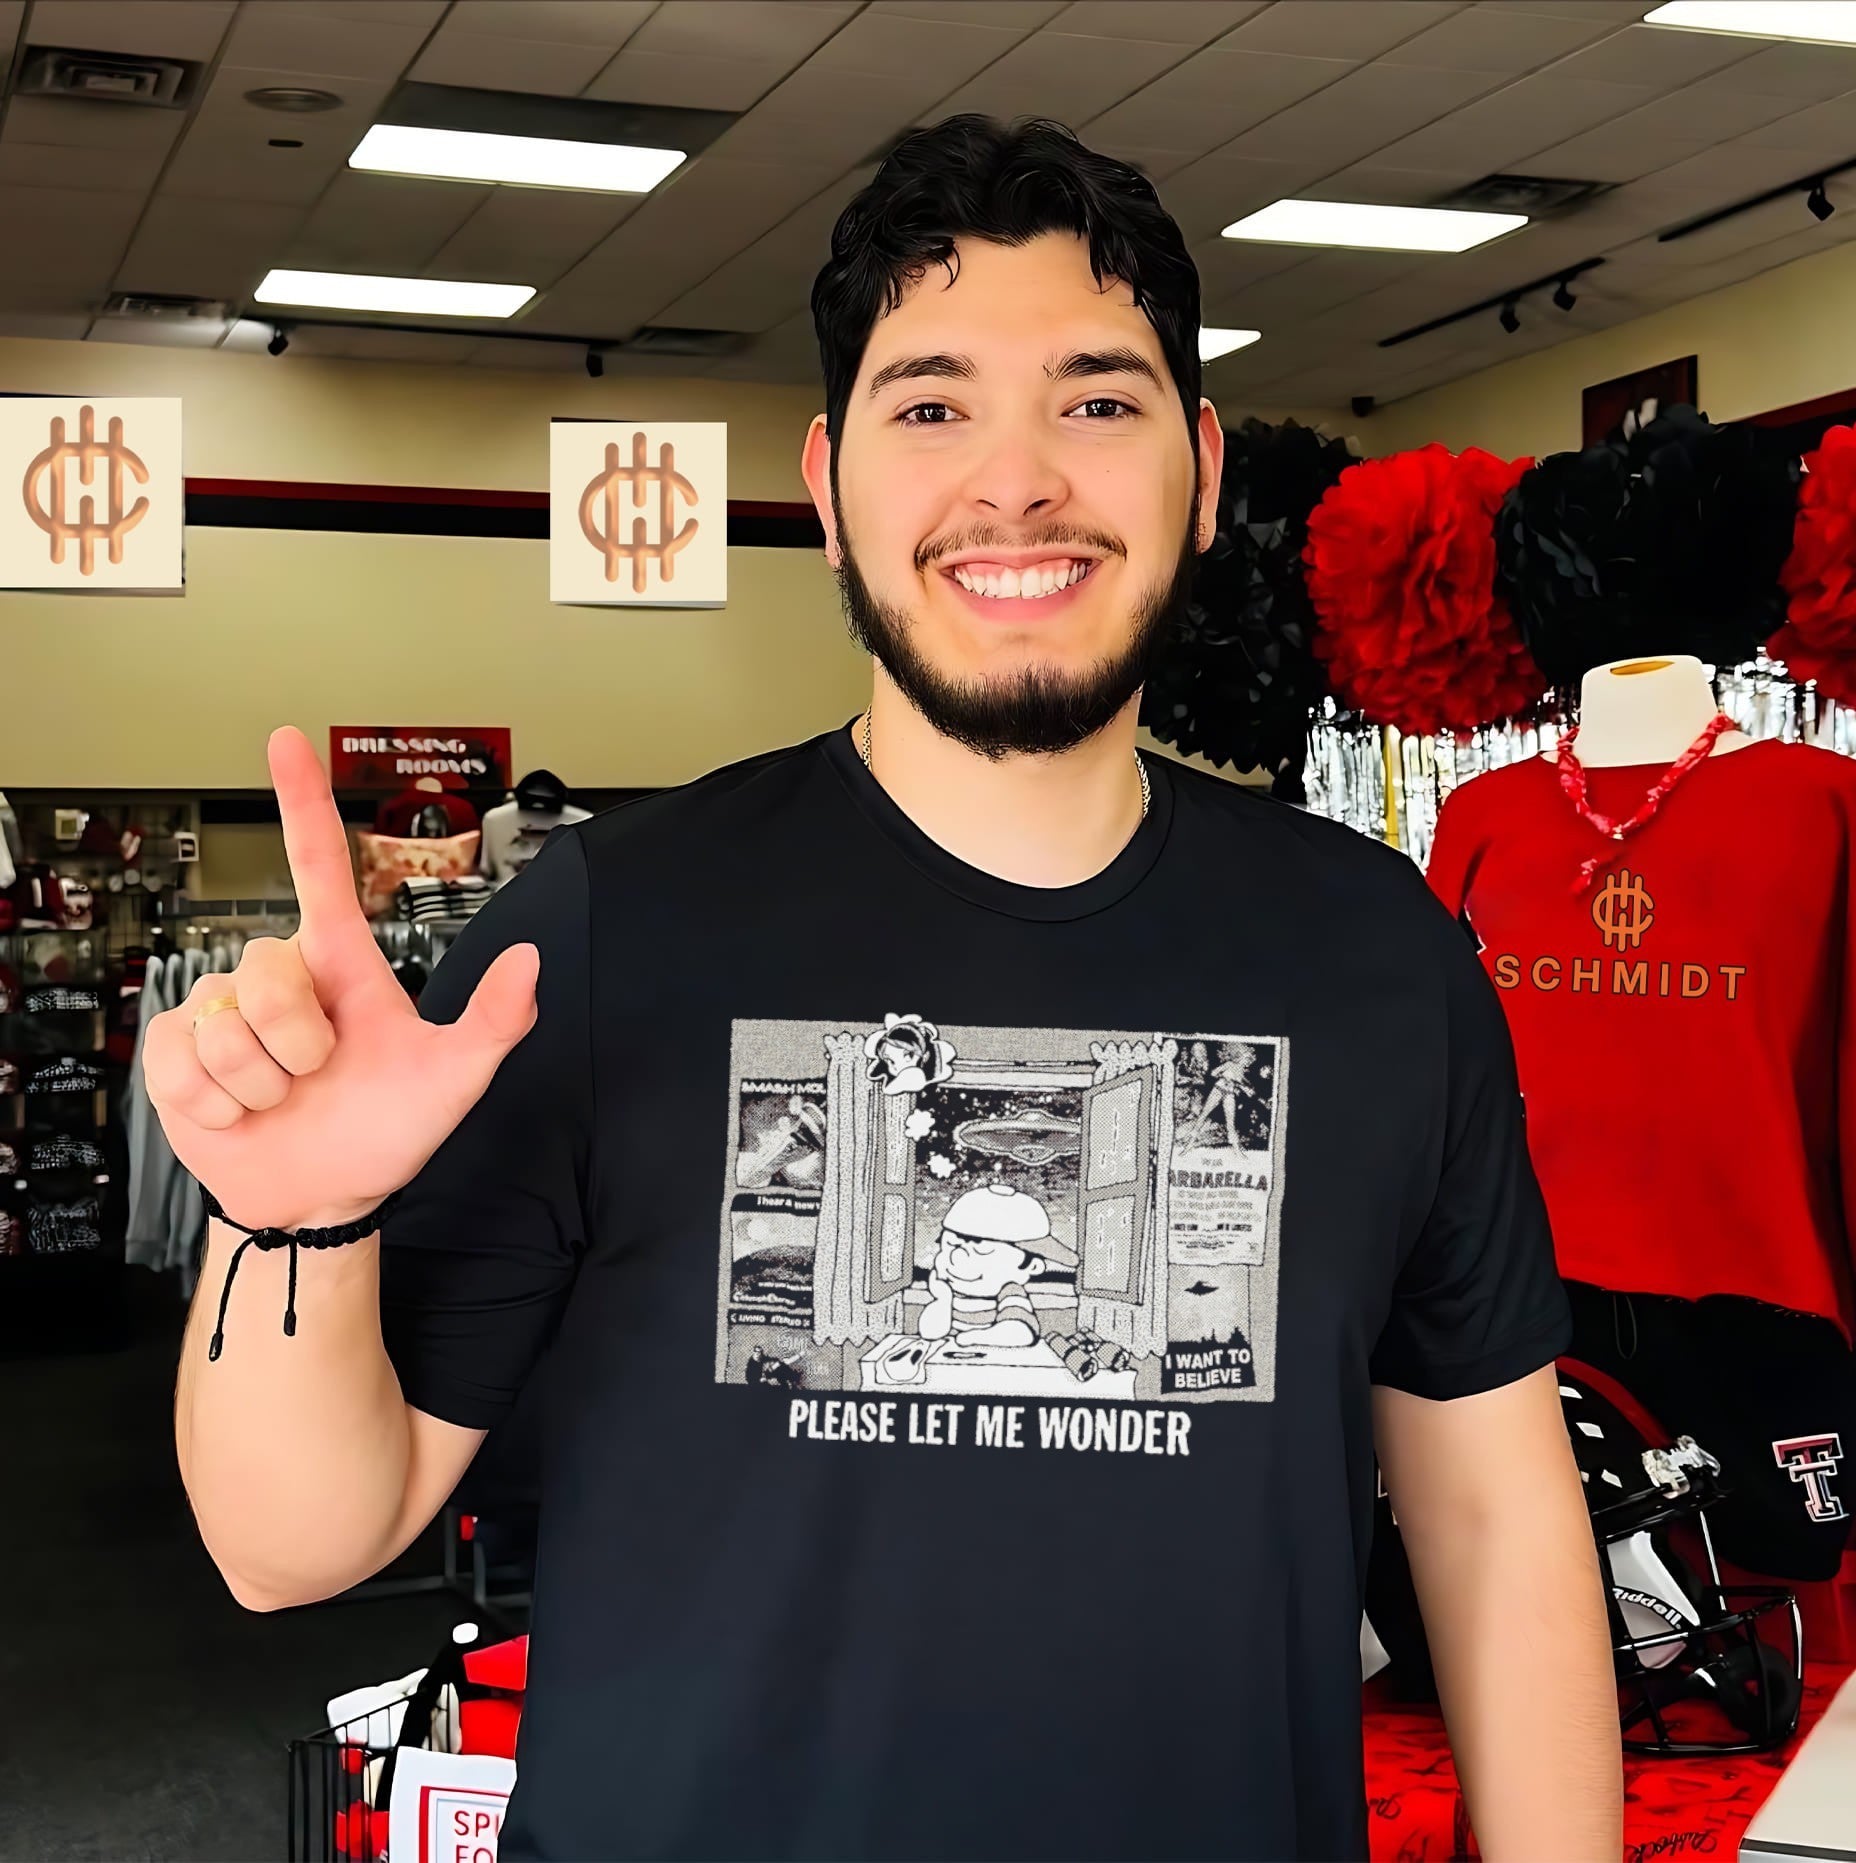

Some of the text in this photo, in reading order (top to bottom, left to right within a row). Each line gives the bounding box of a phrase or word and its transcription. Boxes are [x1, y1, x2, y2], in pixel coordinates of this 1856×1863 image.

[1494, 954, 1747, 1001] SCHMIDT
[1165, 1347, 1251, 1370] I WANT TO
[1174, 1367, 1242, 1389] BELIEVE
[788, 1399, 1192, 1456] PLEASE LET ME WONDER
